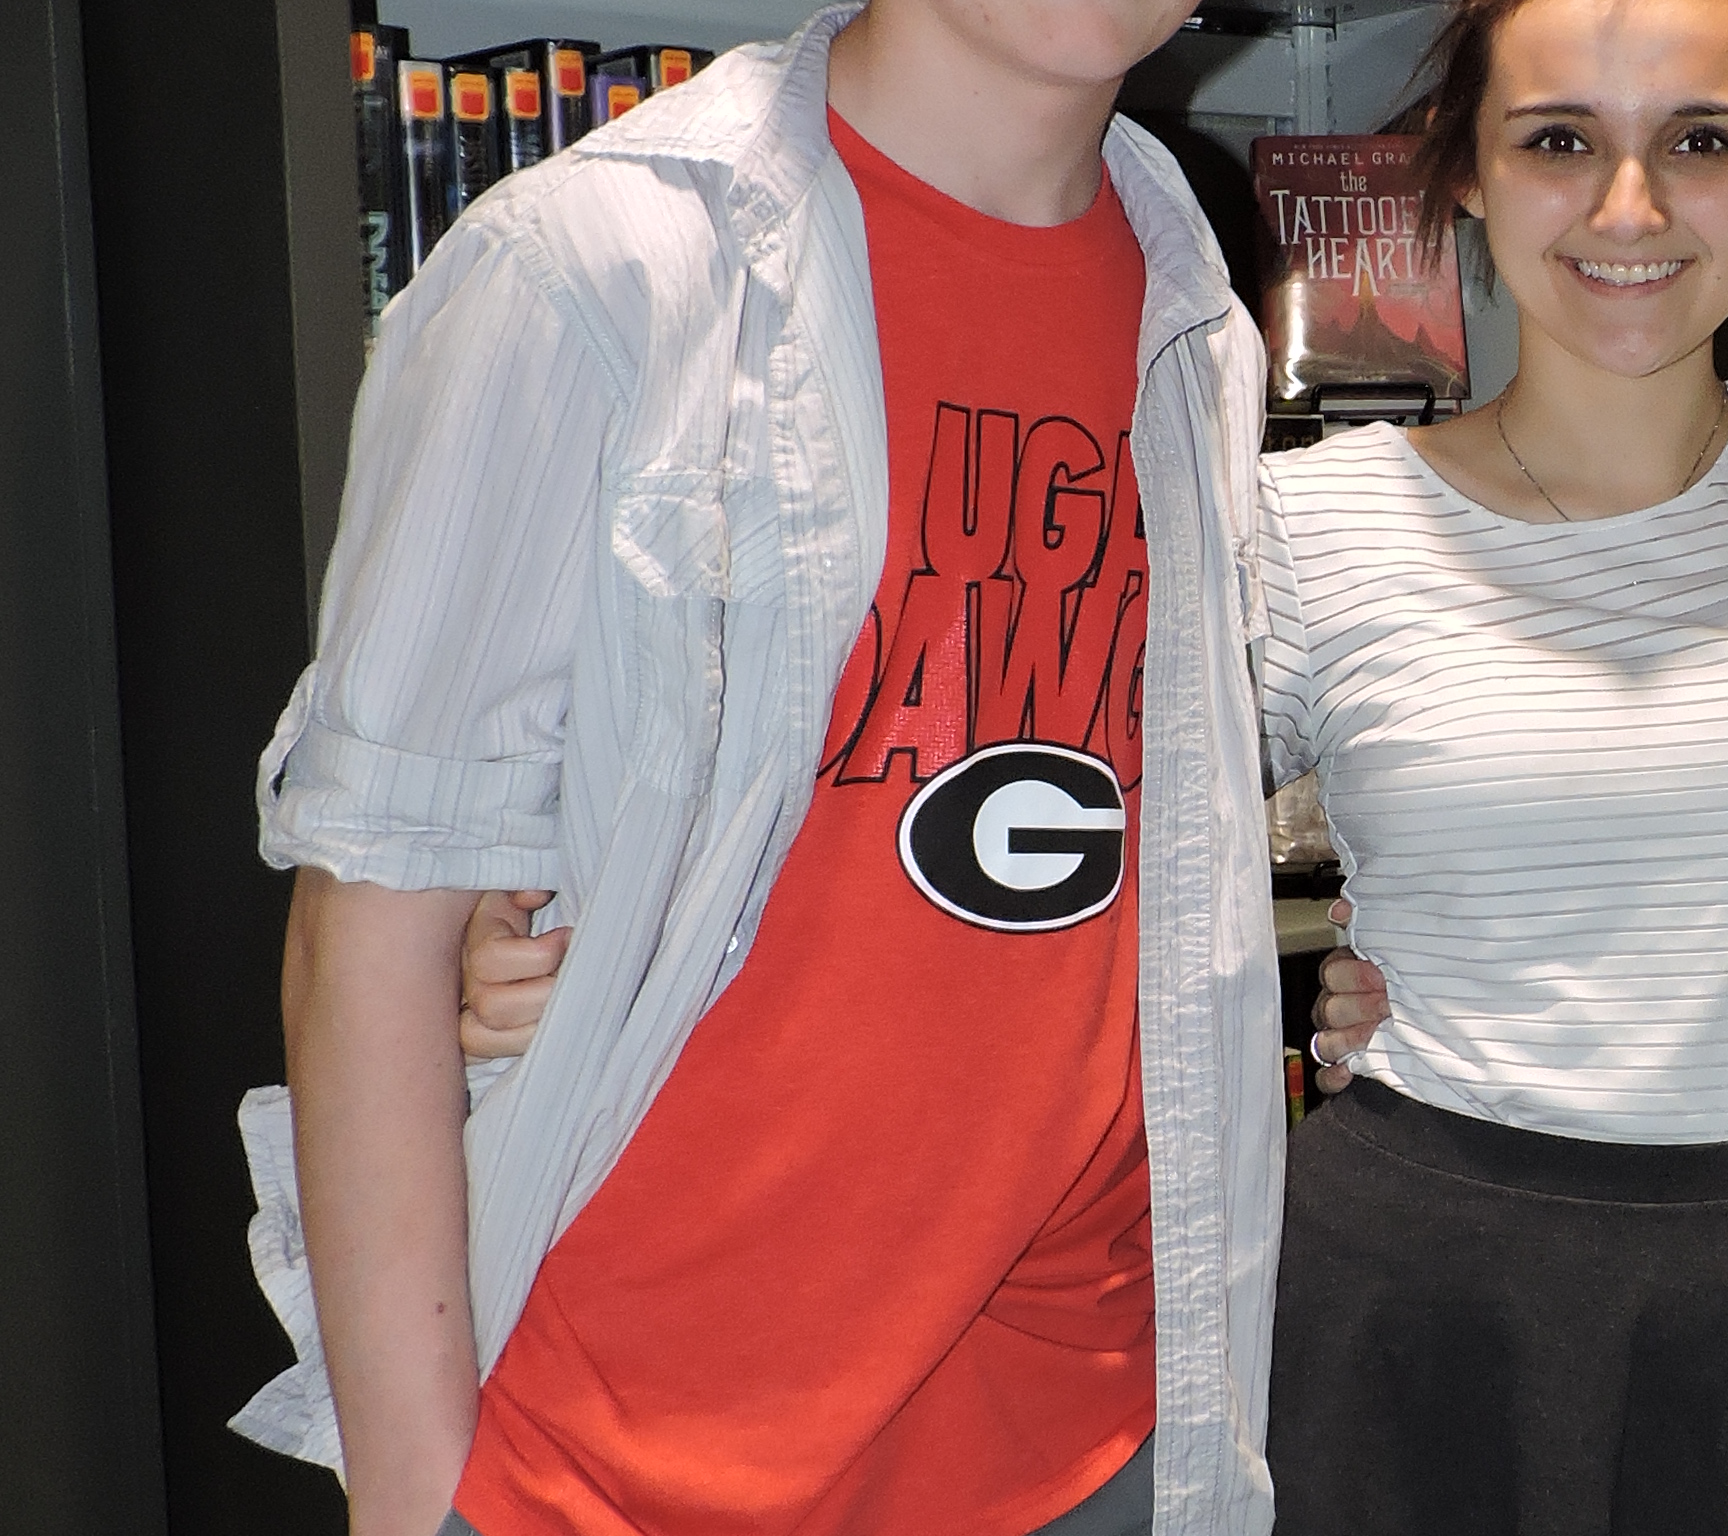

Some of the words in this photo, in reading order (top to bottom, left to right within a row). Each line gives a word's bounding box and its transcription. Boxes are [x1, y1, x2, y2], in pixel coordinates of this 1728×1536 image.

[1271, 151, 1364, 166] MICHAEL
[1339, 169, 1368, 193] the
[1269, 189, 1437, 247] TATTOOE
[1305, 237, 1416, 297] HEART
[896, 738, 1126, 934] G
